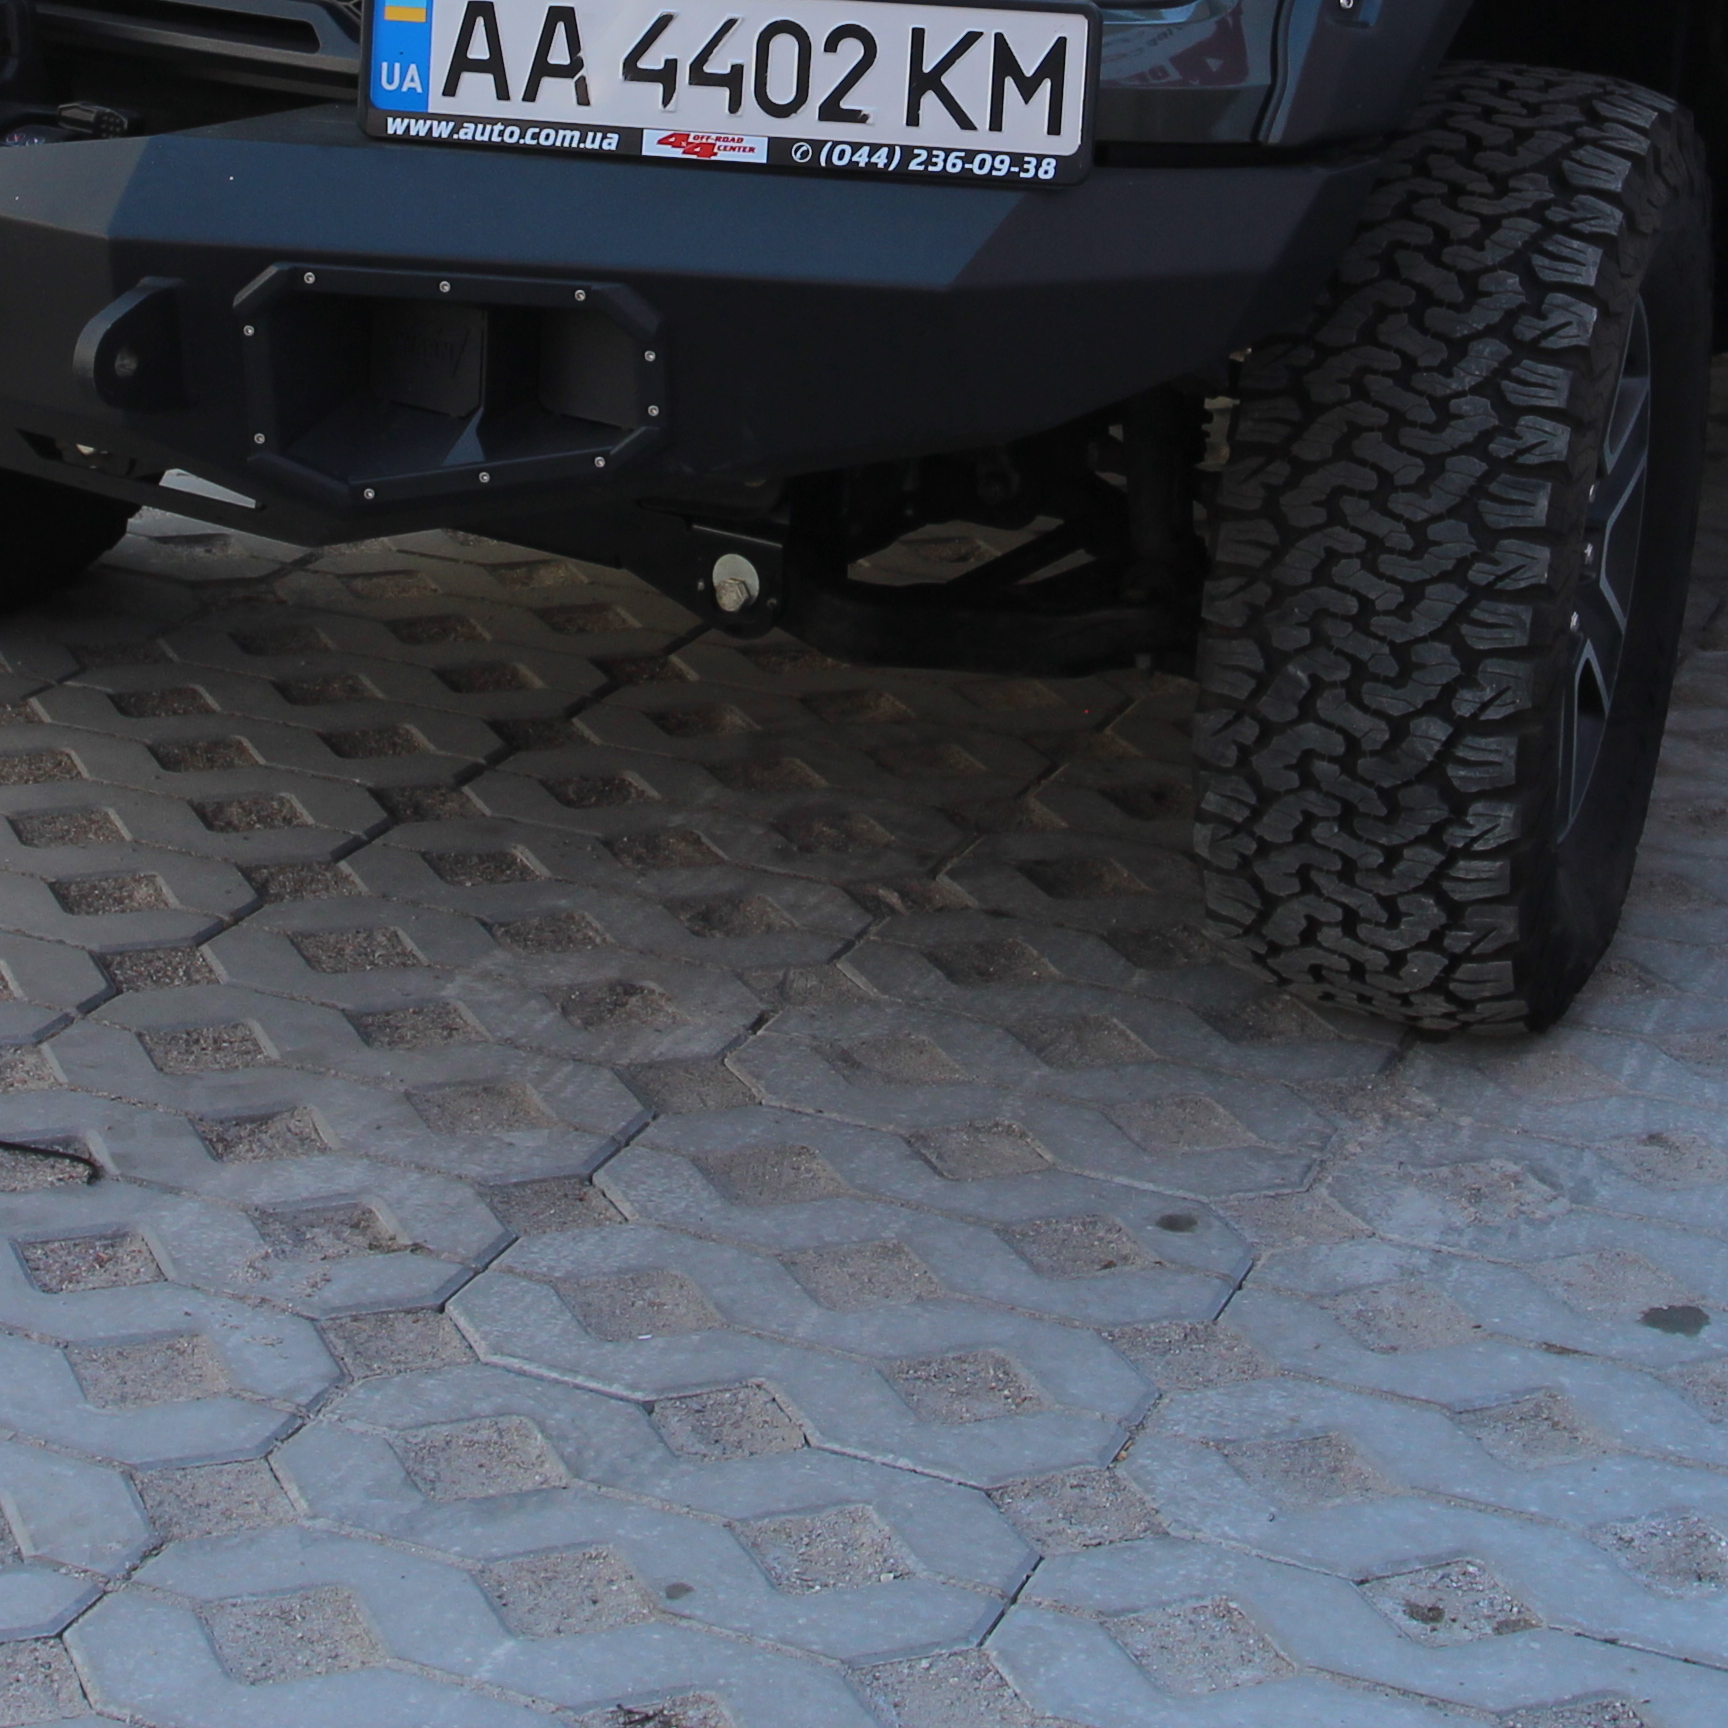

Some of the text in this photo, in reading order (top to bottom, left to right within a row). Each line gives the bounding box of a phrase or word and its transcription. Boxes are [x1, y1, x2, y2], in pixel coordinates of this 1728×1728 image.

[380, 61, 423, 93] UA
[441, 0, 1068, 137] AA 4402 KM
[386, 116, 619, 151] www.auto.com.ua
[692, 134, 744, 144] OFF-ROAD
[716, 144, 756, 153] CENTER
[819, 141, 1057, 180] (044) 236-09-38
